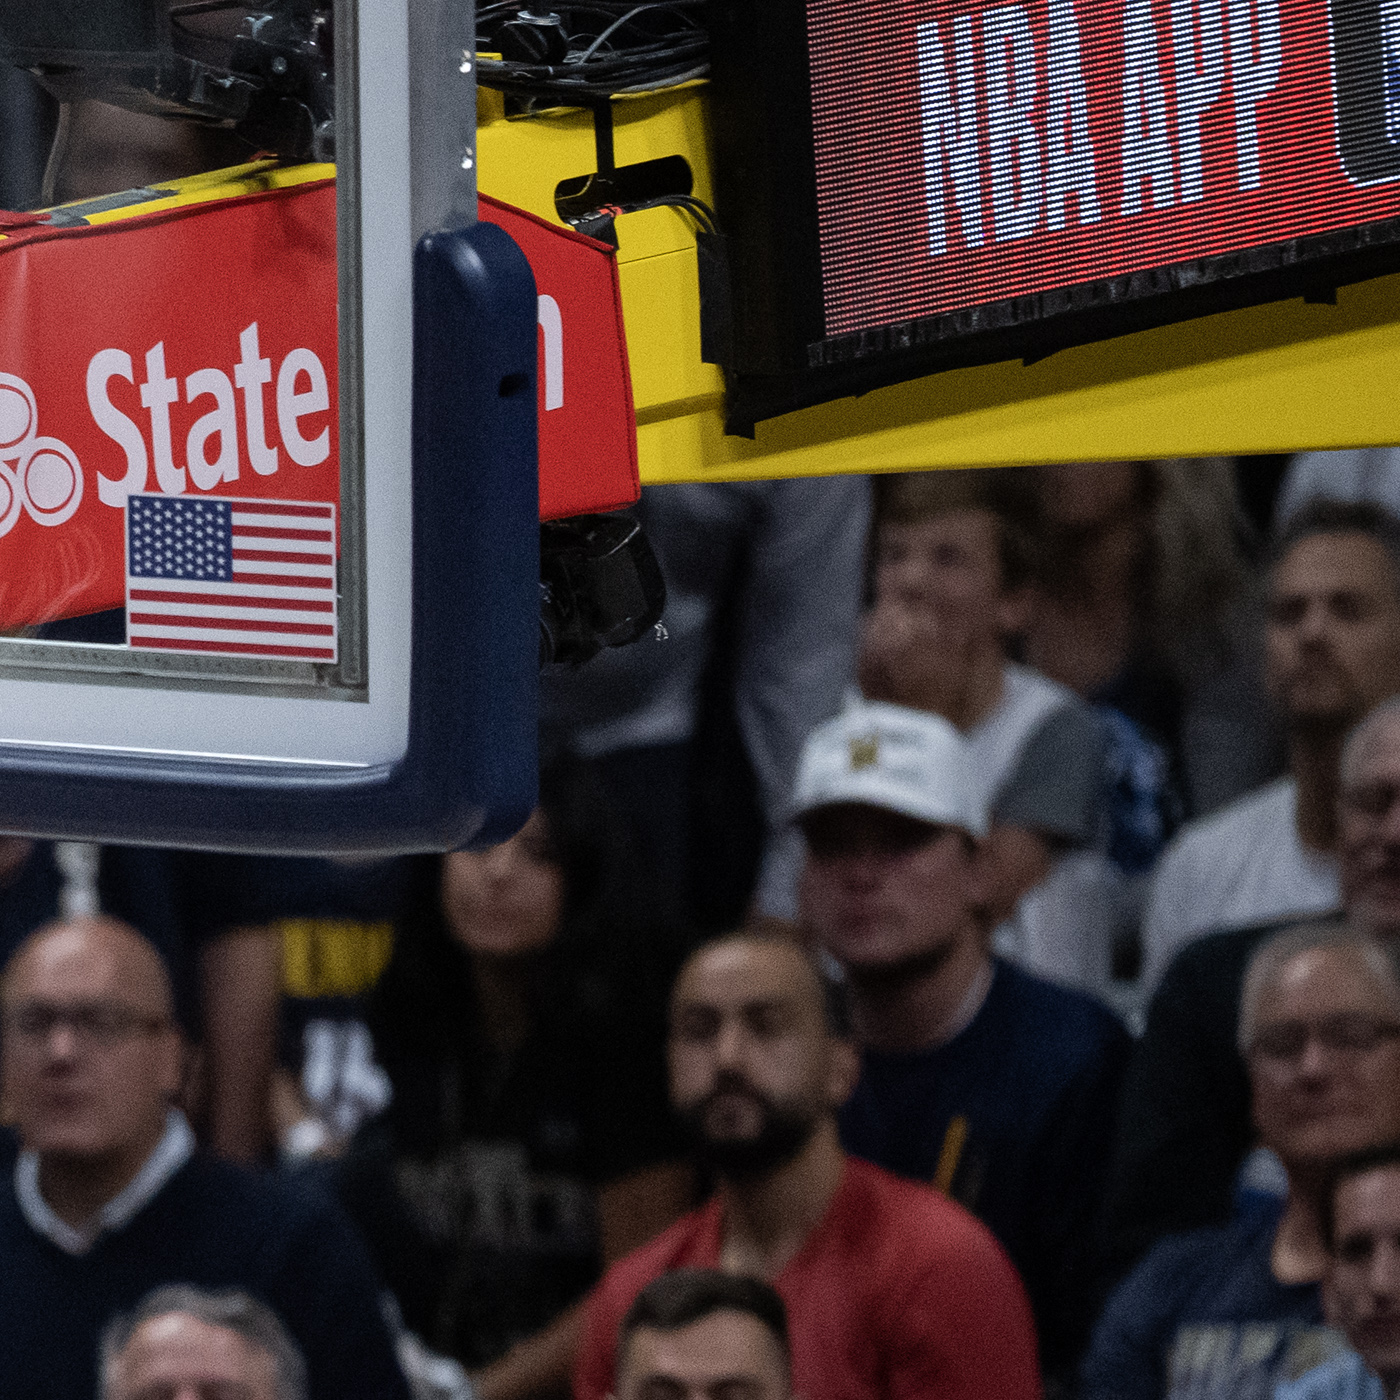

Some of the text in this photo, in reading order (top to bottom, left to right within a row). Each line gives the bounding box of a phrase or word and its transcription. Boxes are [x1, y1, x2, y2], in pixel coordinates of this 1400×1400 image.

[917, 0, 1283, 256] NBA APP
[86, 321, 330, 508] State
